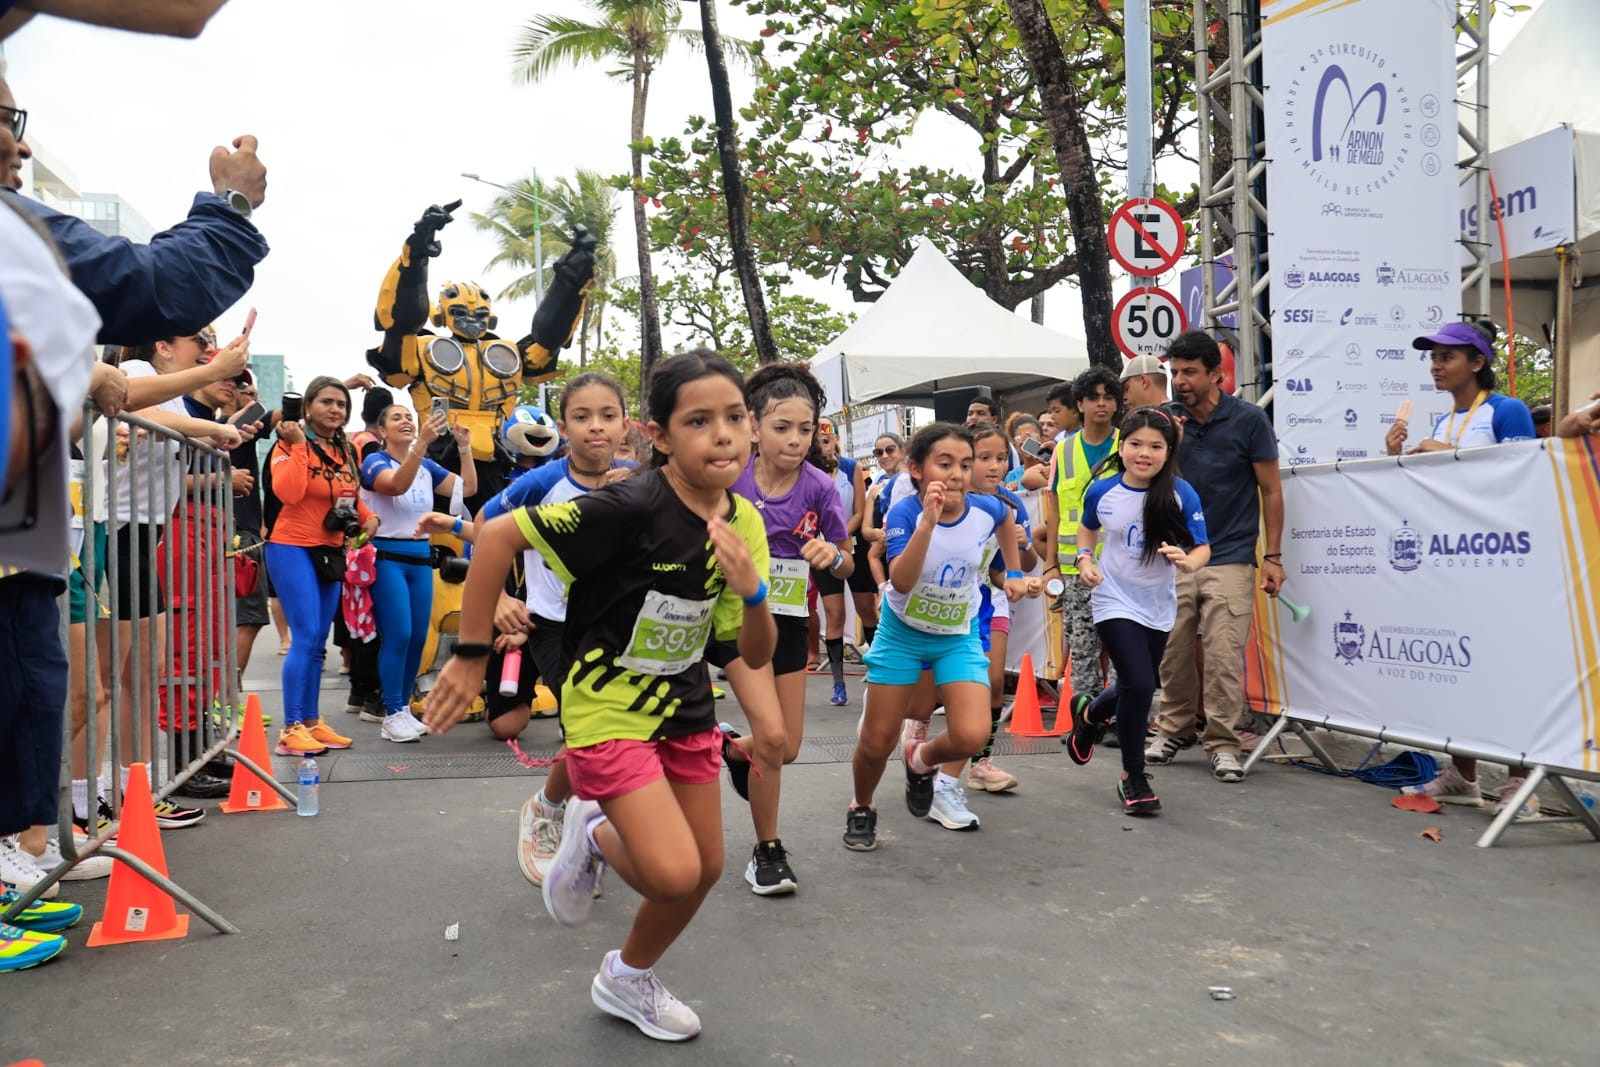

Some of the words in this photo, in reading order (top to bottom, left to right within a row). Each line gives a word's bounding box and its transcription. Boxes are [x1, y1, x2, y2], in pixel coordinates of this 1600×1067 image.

[1329, 43, 1385, 69] CIRCUITO
[1346, 130, 1384, 150] ARNON
[1347, 149, 1358, 164] DE
[1359, 150, 1384, 166] MELLO
[1302, 160, 1338, 192] MELLO
[1366, 147, 1409, 193] CORRIDA
[1134, 213, 1160, 258] E
[1308, 271, 1360, 283] ALAGOAS
[1128, 304, 1174, 339] 50
[1286, 378, 1313, 392] OAB
[1288, 456, 1317, 466] COPRA
[1290, 526, 1331, 540] Secretaria
[1332, 527, 1343, 539] de
[1345, 525, 1376, 538] Estado
[1326, 545, 1338, 557] do
[1340, 544, 1376, 559] Esporte,
[1428, 531, 1531, 555] ALAGOAS
[1301, 562, 1322, 575] Lazer
[1323, 565, 1330, 575] e
[1330, 562, 1376, 575] Juventude
[1433, 558, 1526, 568] GOVERNO
[768, 578, 796, 598] 27
[915, 598, 963, 621] 3936
[1367, 629, 1472, 668] ALAGOAS
[1376, 667, 1384, 676] A
[1386, 668, 1407, 679] VOZ
[1410, 670, 1425, 681] DO
[1429, 672, 1459, 685] POVO
